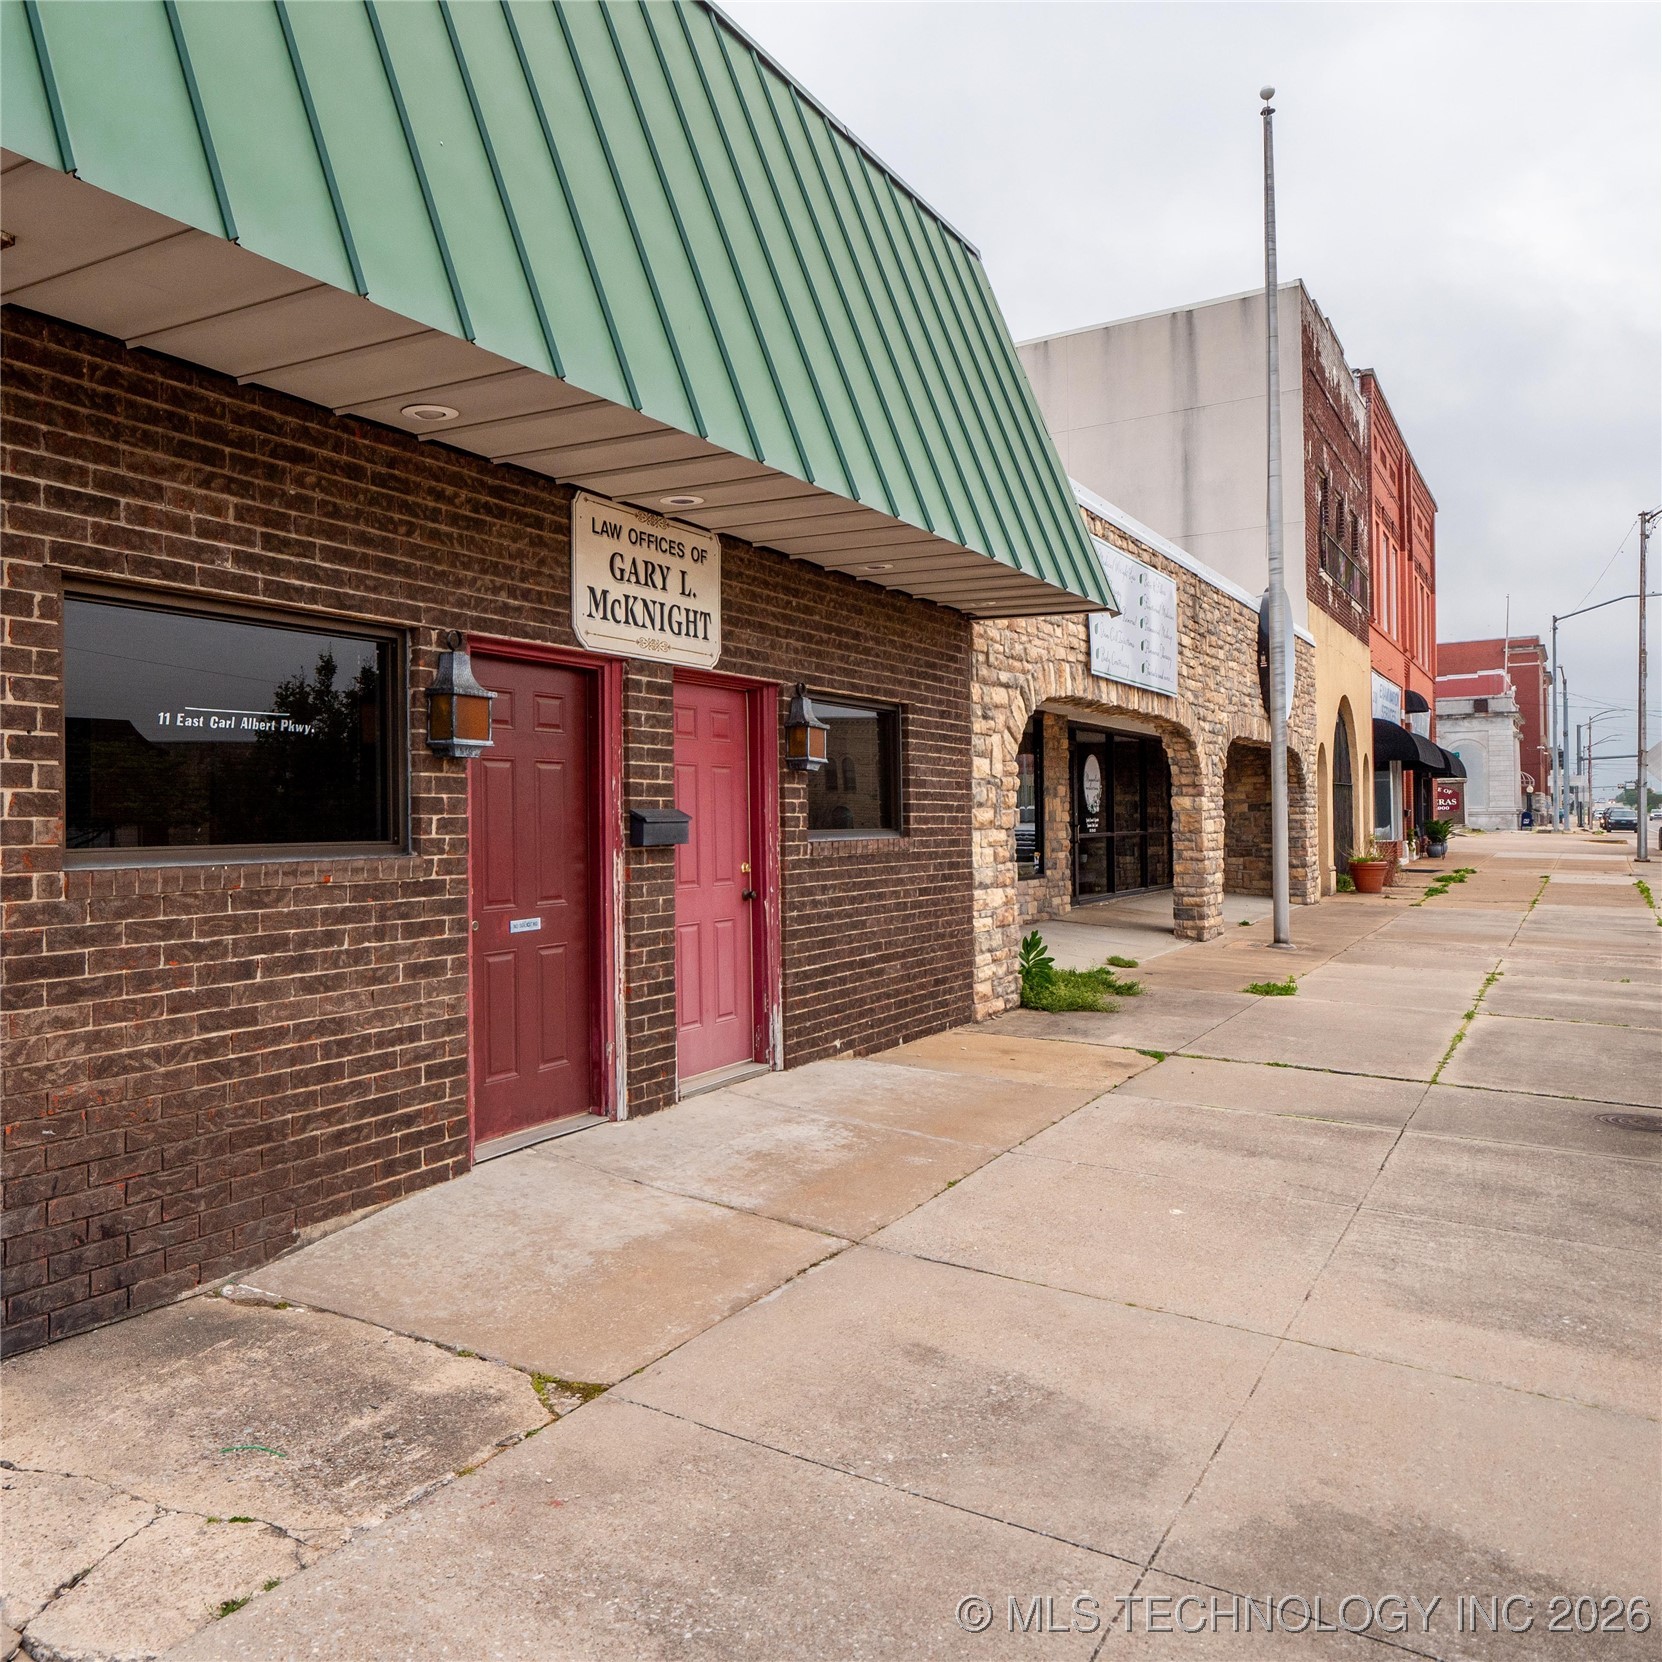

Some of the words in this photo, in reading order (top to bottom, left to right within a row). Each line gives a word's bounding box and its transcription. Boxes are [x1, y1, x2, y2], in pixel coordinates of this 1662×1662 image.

[591, 516, 622, 540] LAW
[628, 528, 685, 558] OFFICES
[691, 546, 708, 563] OF
[609, 552, 671, 592] GARY
[679, 570, 697, 599] L.
[586, 585, 712, 640] McKNIGHT
[158, 712, 170, 725] 11
[176, 713, 203, 727] East
[209, 716, 235, 729] Carl
[240, 717, 275, 731] Albert
[280, 719, 315, 735] Pkwy.
